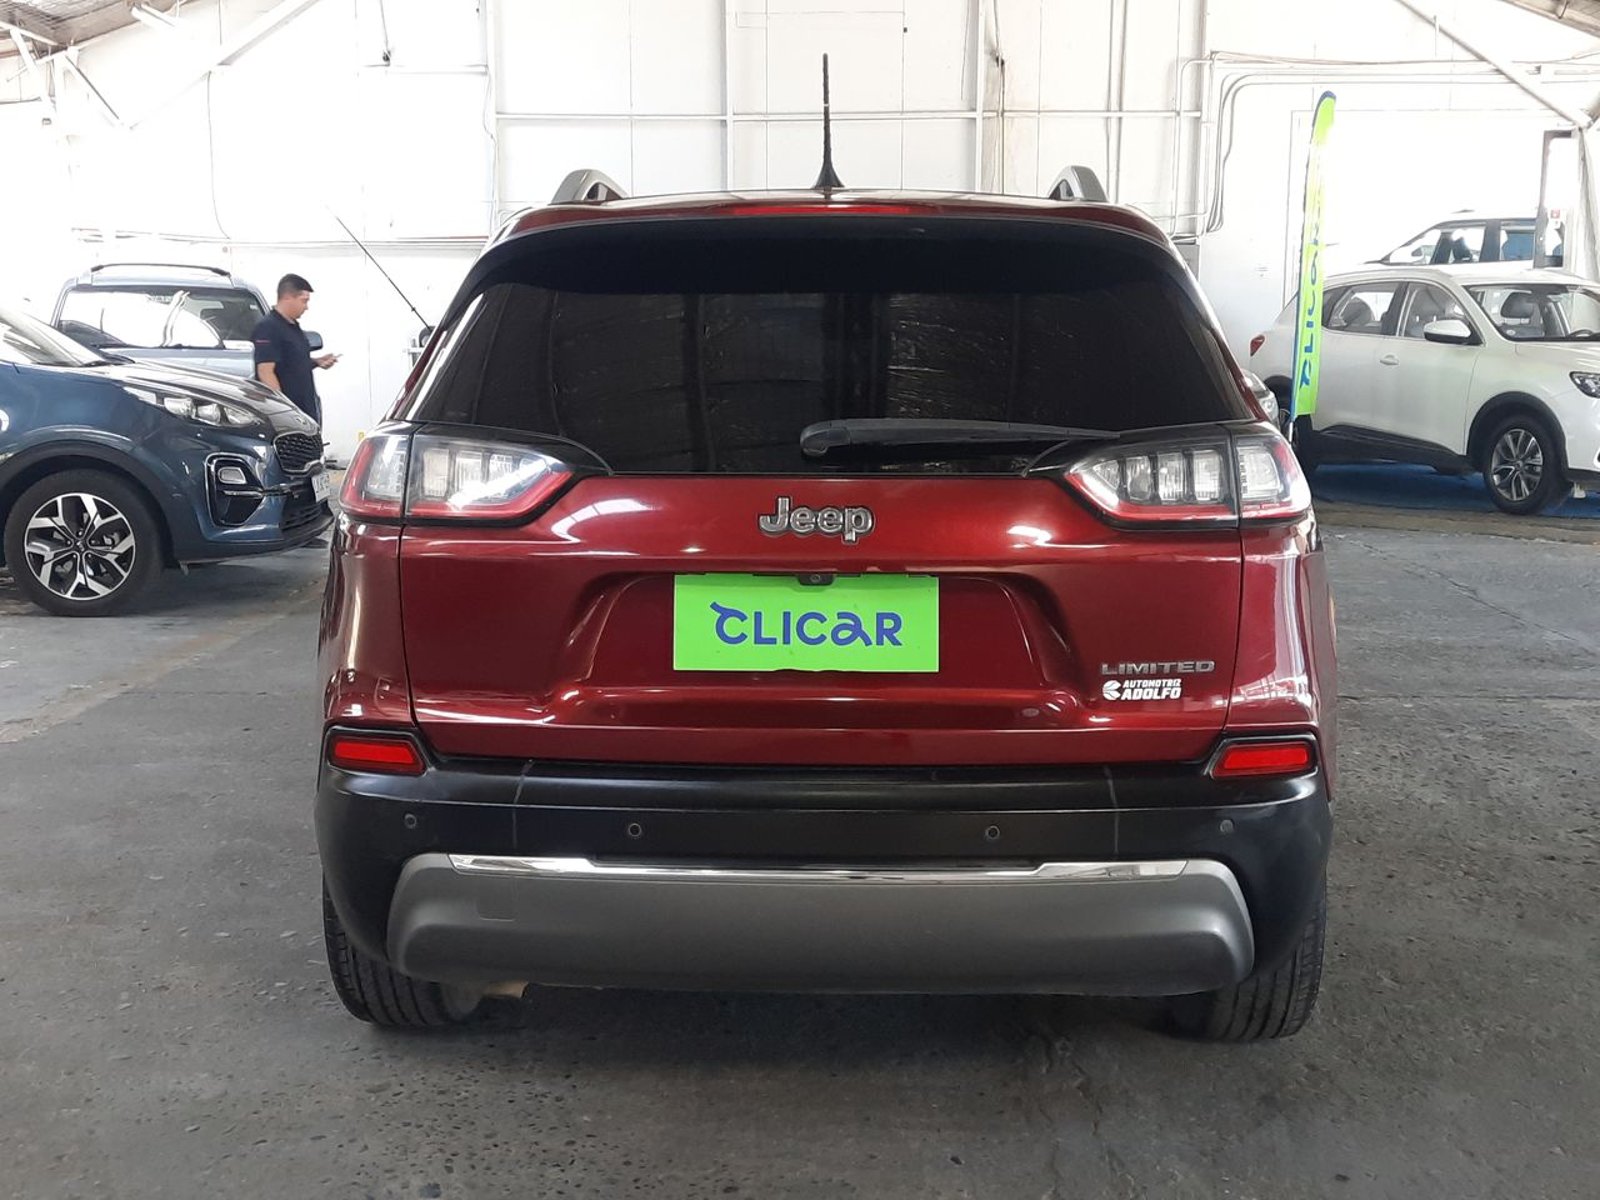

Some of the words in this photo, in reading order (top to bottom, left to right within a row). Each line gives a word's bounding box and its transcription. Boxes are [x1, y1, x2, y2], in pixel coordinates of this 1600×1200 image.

[758, 497, 874, 543] Jeep
[709, 602, 903, 646] CLICAR
[1101, 660, 1216, 675] LIMITED
[1122, 678, 1182, 689] AUTOMOTRIZ
[1120, 687, 1182, 700] ADOLFO
